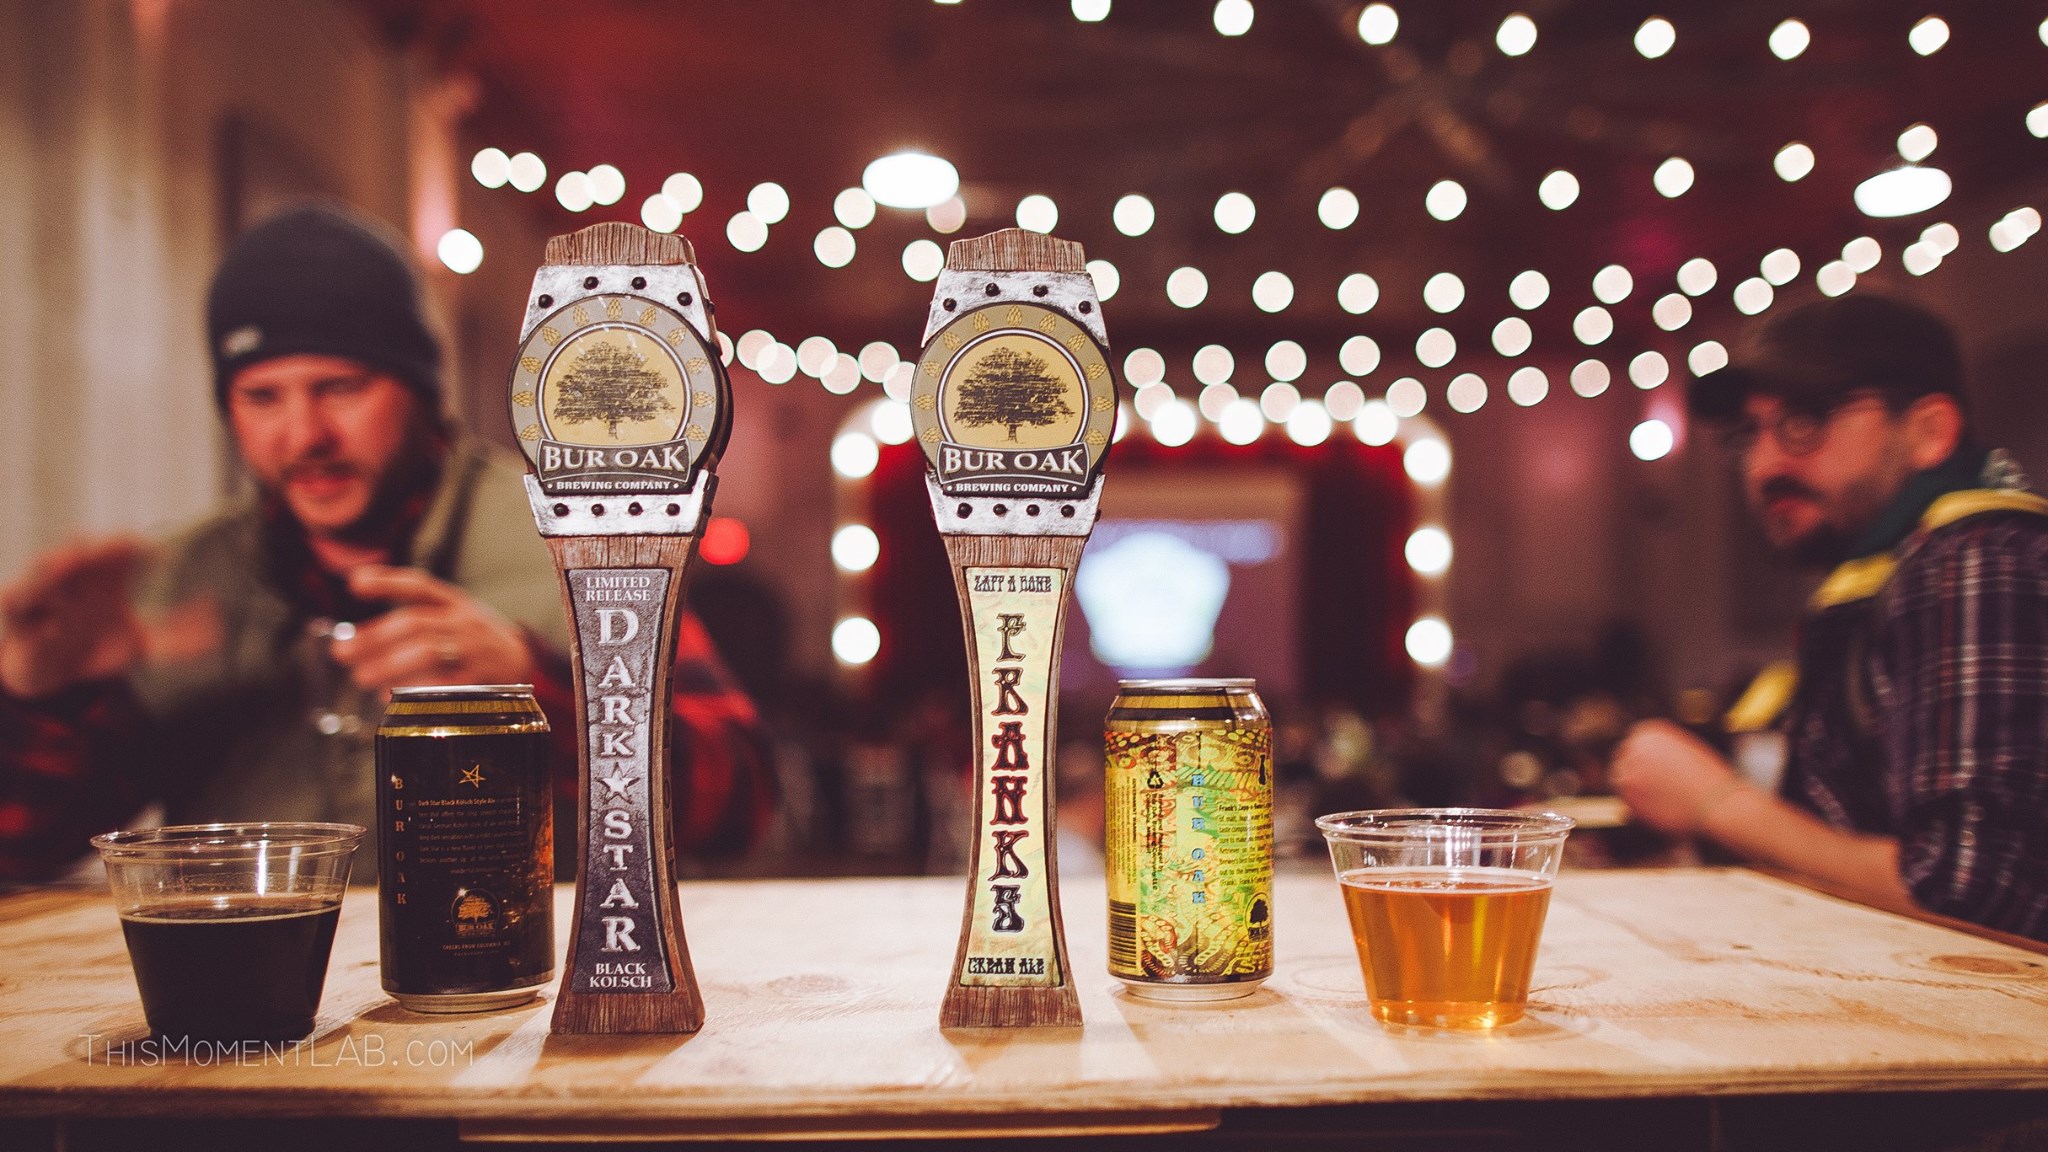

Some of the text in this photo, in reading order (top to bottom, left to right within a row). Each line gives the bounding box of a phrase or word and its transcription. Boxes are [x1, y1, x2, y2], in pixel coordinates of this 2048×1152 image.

[543, 445, 685, 472] BUR OAK
[943, 448, 1084, 475] BUR OAK
[556, 481, 671, 490] BREWING COMPANY
[956, 483, 1069, 492] BREWING COMPANY
[586, 577, 650, 589] LIMITED
[586, 590, 651, 601] RELEASE
[595, 609, 641, 952] DARK STAR
[988, 613, 1029, 932] FRANKS
[395, 778, 407, 904] BUR OAK
[1192, 774, 1206, 904] BUR OAK
[595, 963, 647, 975] BLACK
[967, 957, 1045, 975] CREAM ALE
[589, 976, 652, 988] KOLSCH
